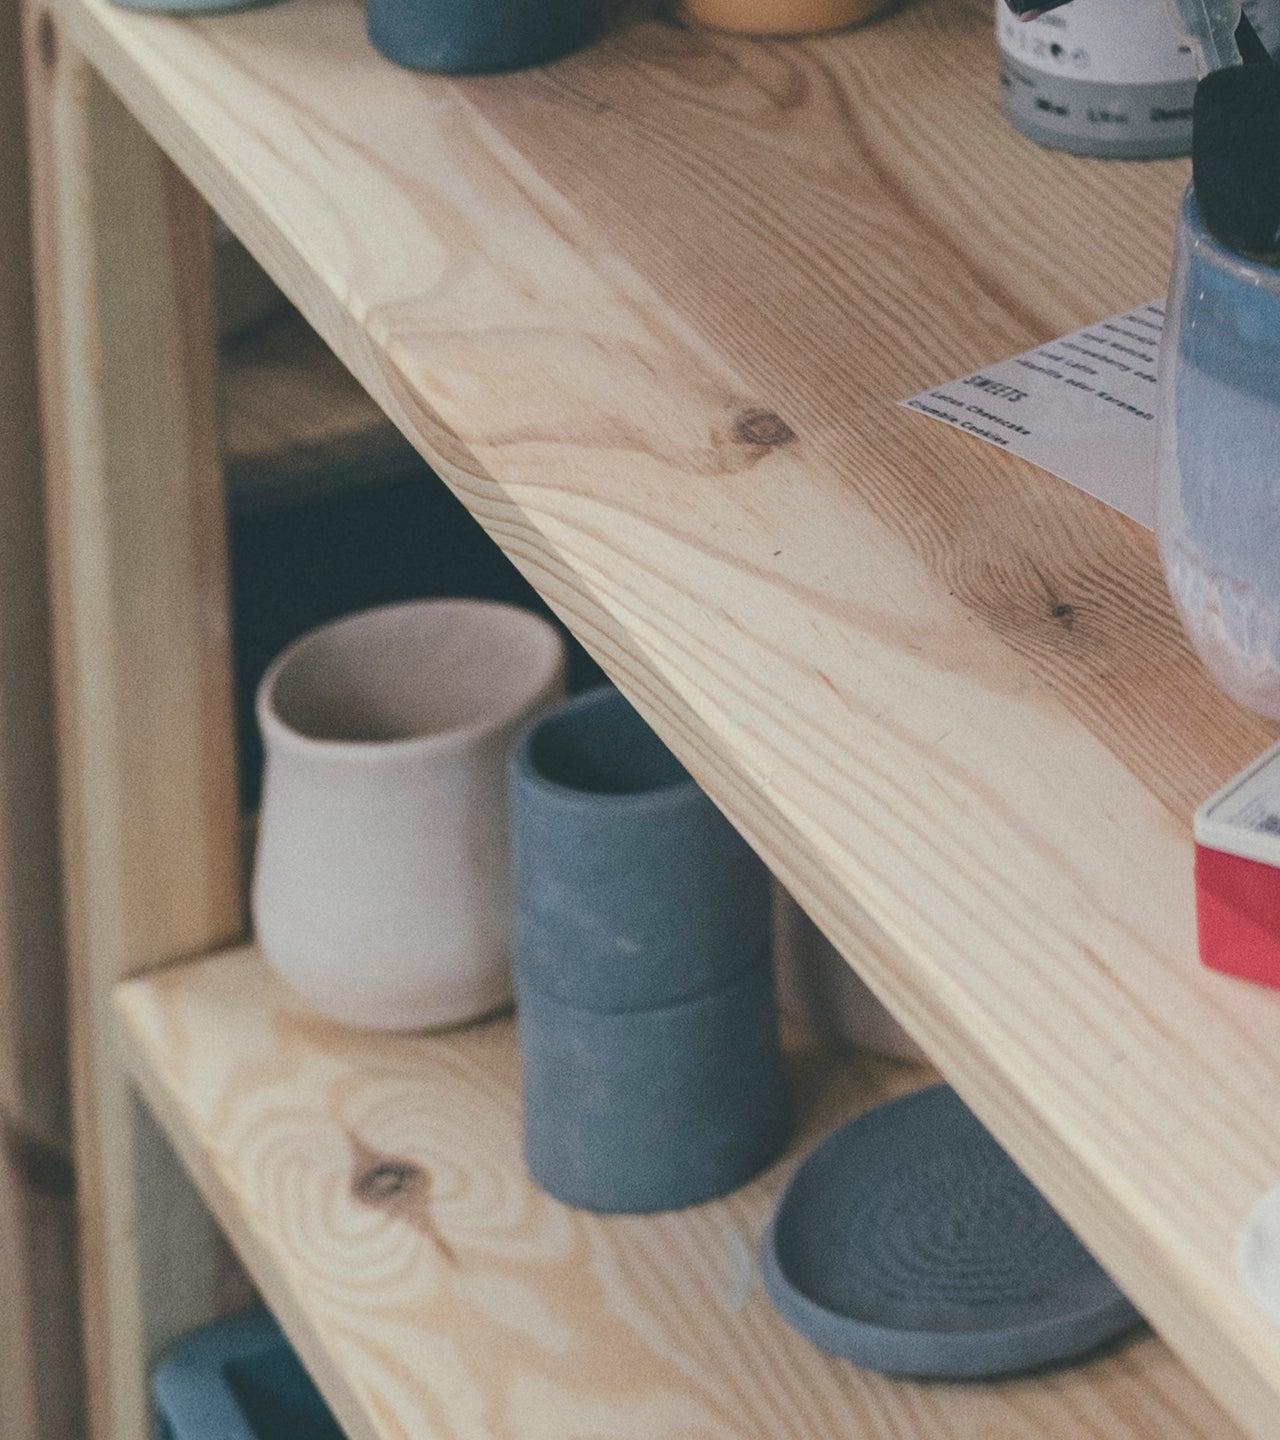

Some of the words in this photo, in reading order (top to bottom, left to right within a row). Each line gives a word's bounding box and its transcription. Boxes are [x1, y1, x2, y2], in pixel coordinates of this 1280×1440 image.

[962, 375, 1029, 403] SWEETS
[907, 400, 959, 423] Crumble
[960, 421, 1010, 445] Cookies
